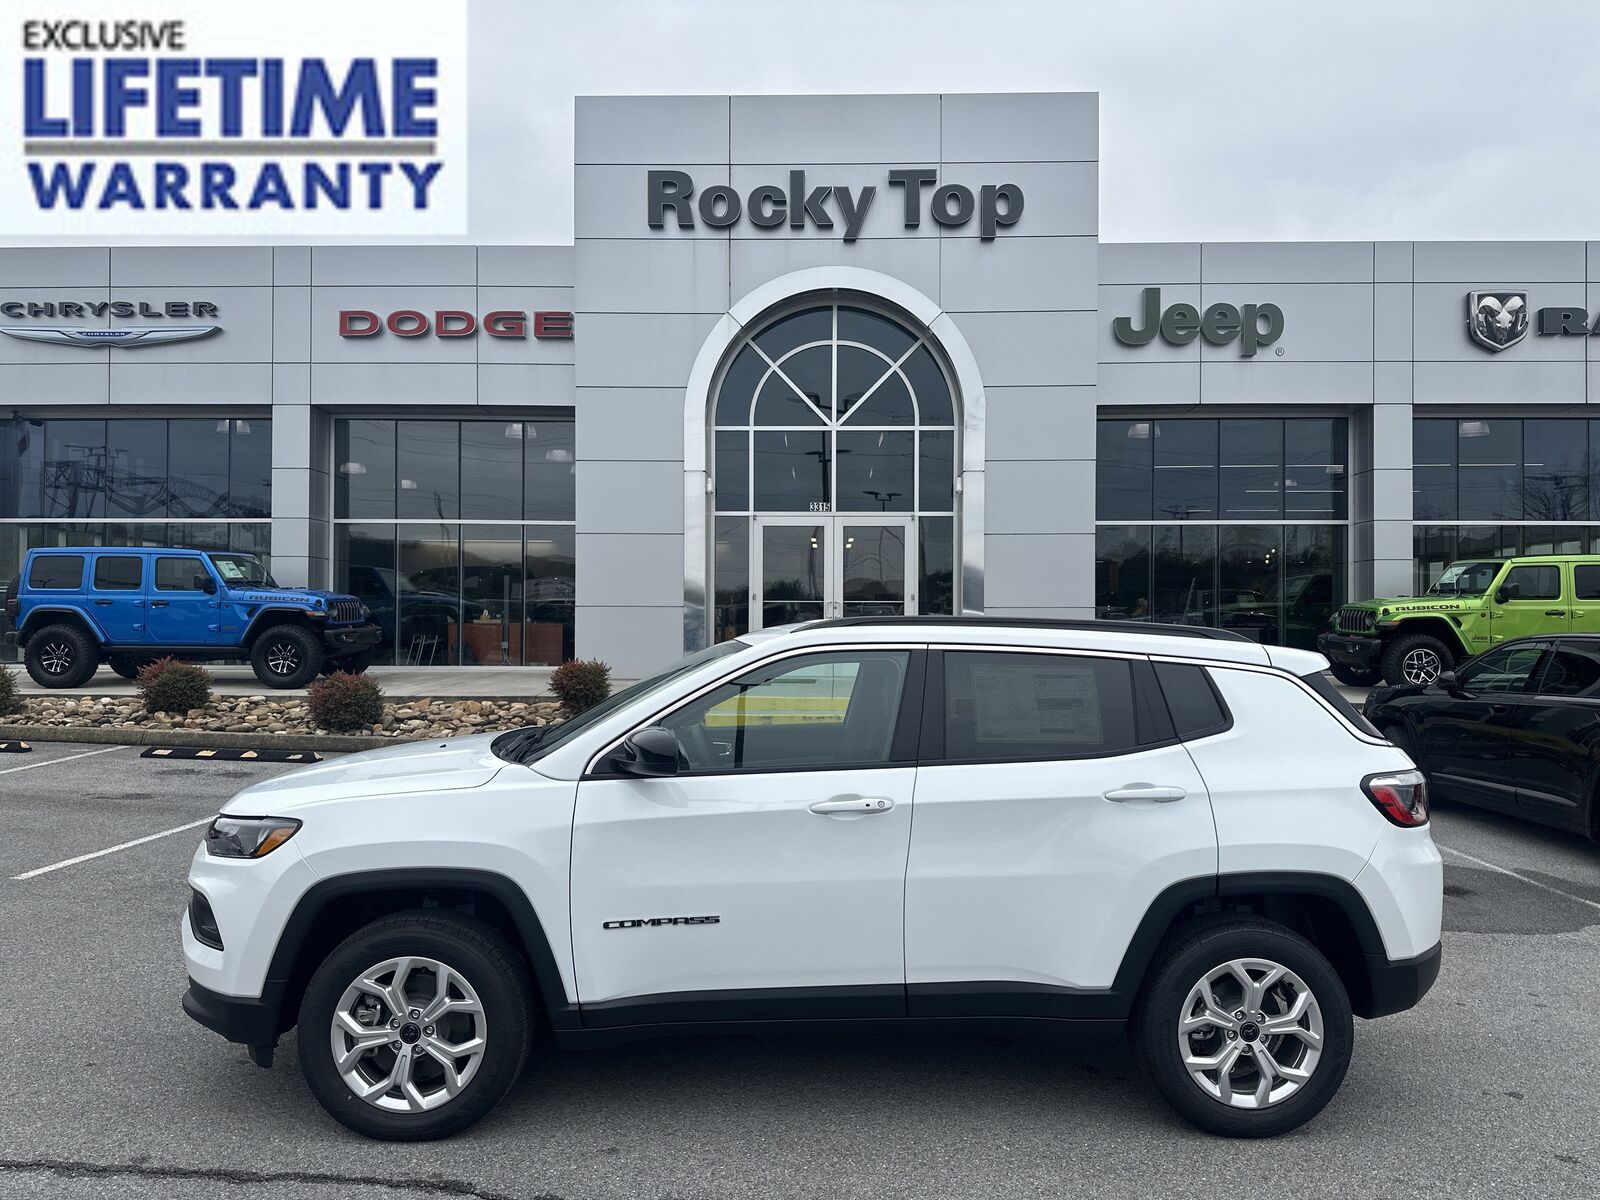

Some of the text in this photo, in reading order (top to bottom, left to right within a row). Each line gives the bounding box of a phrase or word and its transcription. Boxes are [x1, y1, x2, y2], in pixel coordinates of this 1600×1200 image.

[647, 168, 1025, 242] Rocky Top
[0, 301, 218, 318] CHRYSLER
[339, 310, 574, 340] DODGE
[1113, 287, 1285, 358] Jeep
[1538, 307, 1600, 335] R
[811, 502, 830, 511] 3315
[1396, 604, 1460, 612] RUBICON
[603, 915, 720, 930] COMPASS
